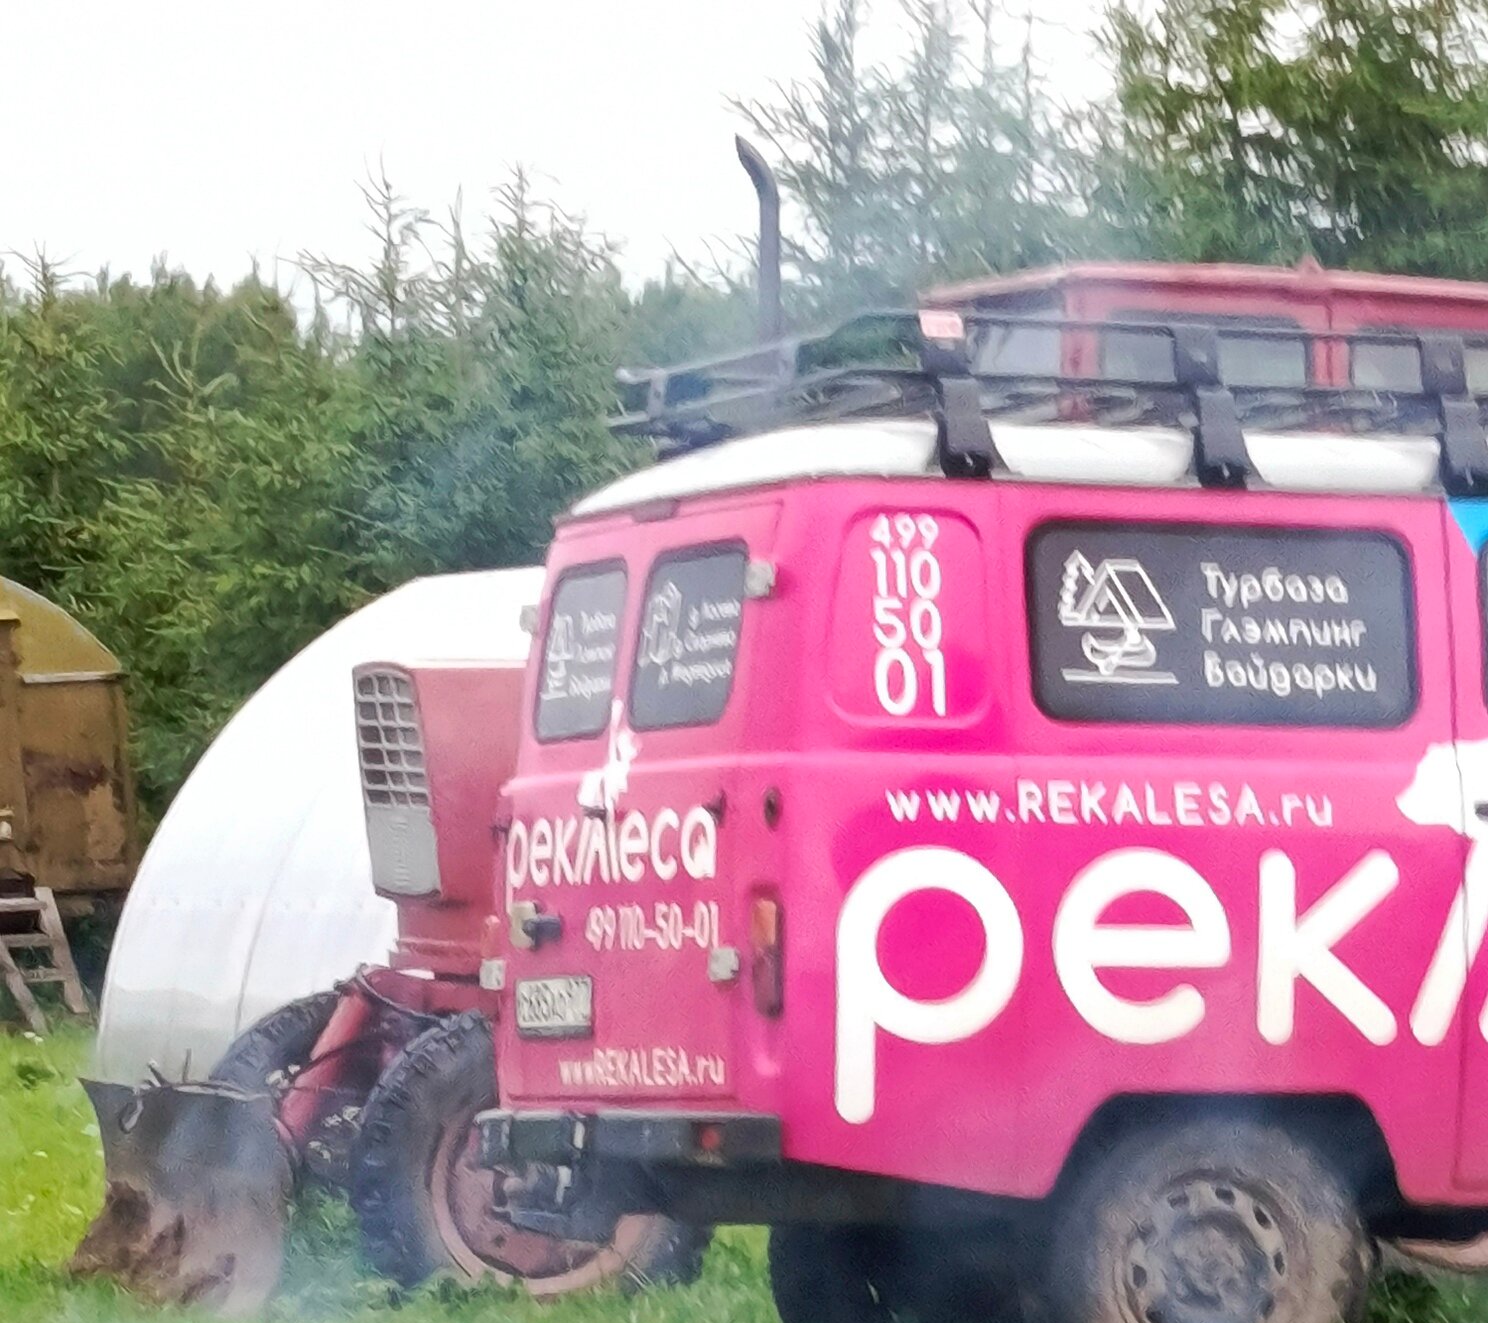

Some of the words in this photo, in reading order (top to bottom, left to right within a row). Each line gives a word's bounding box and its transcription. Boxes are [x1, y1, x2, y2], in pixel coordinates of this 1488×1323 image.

[869, 513, 940, 550] 499
[869, 546, 942, 600] 110
[1200, 562, 1349, 609] Турбаза
[873, 595, 943, 651] 50
[1201, 607, 1367, 648] Глэмпинг
[874, 647, 947, 717] 01
[1203, 650, 1378, 700] Байдарки
[885, 778, 1334, 828] www.REKALESA.ru
